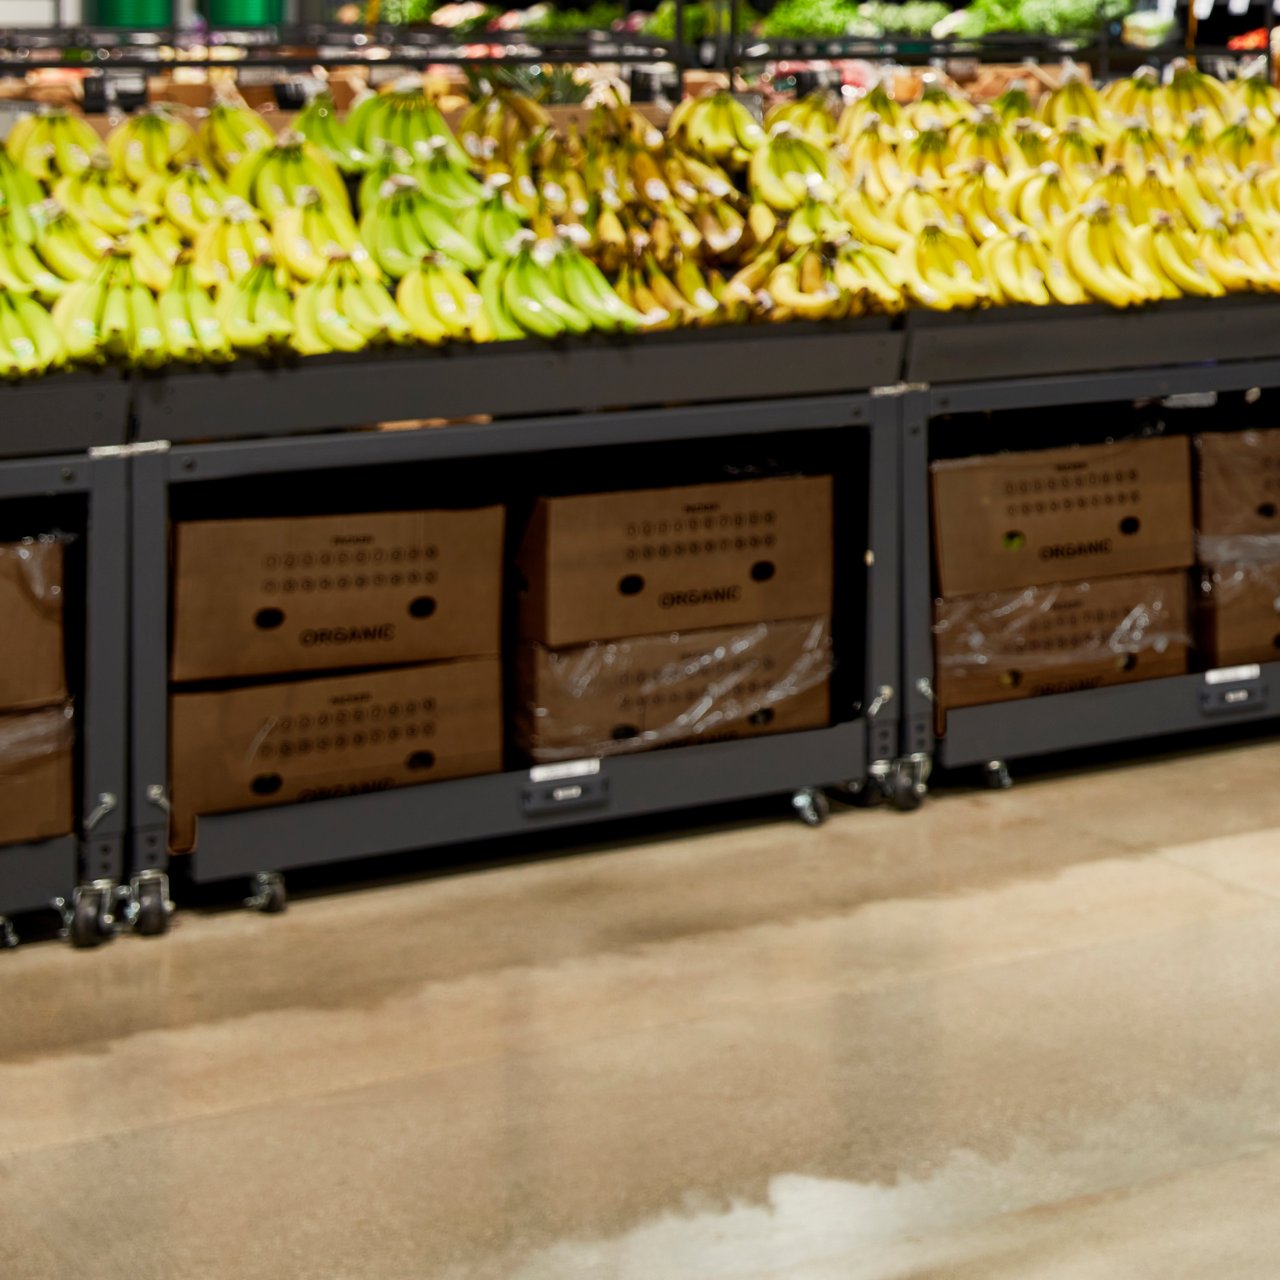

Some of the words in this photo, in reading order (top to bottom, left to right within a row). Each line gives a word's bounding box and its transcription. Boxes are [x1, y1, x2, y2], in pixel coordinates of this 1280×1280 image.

[1039, 539, 1112, 561] ORGANIC
[659, 586, 742, 608] ORGANIC
[300, 624, 395, 647] ORGANIC
